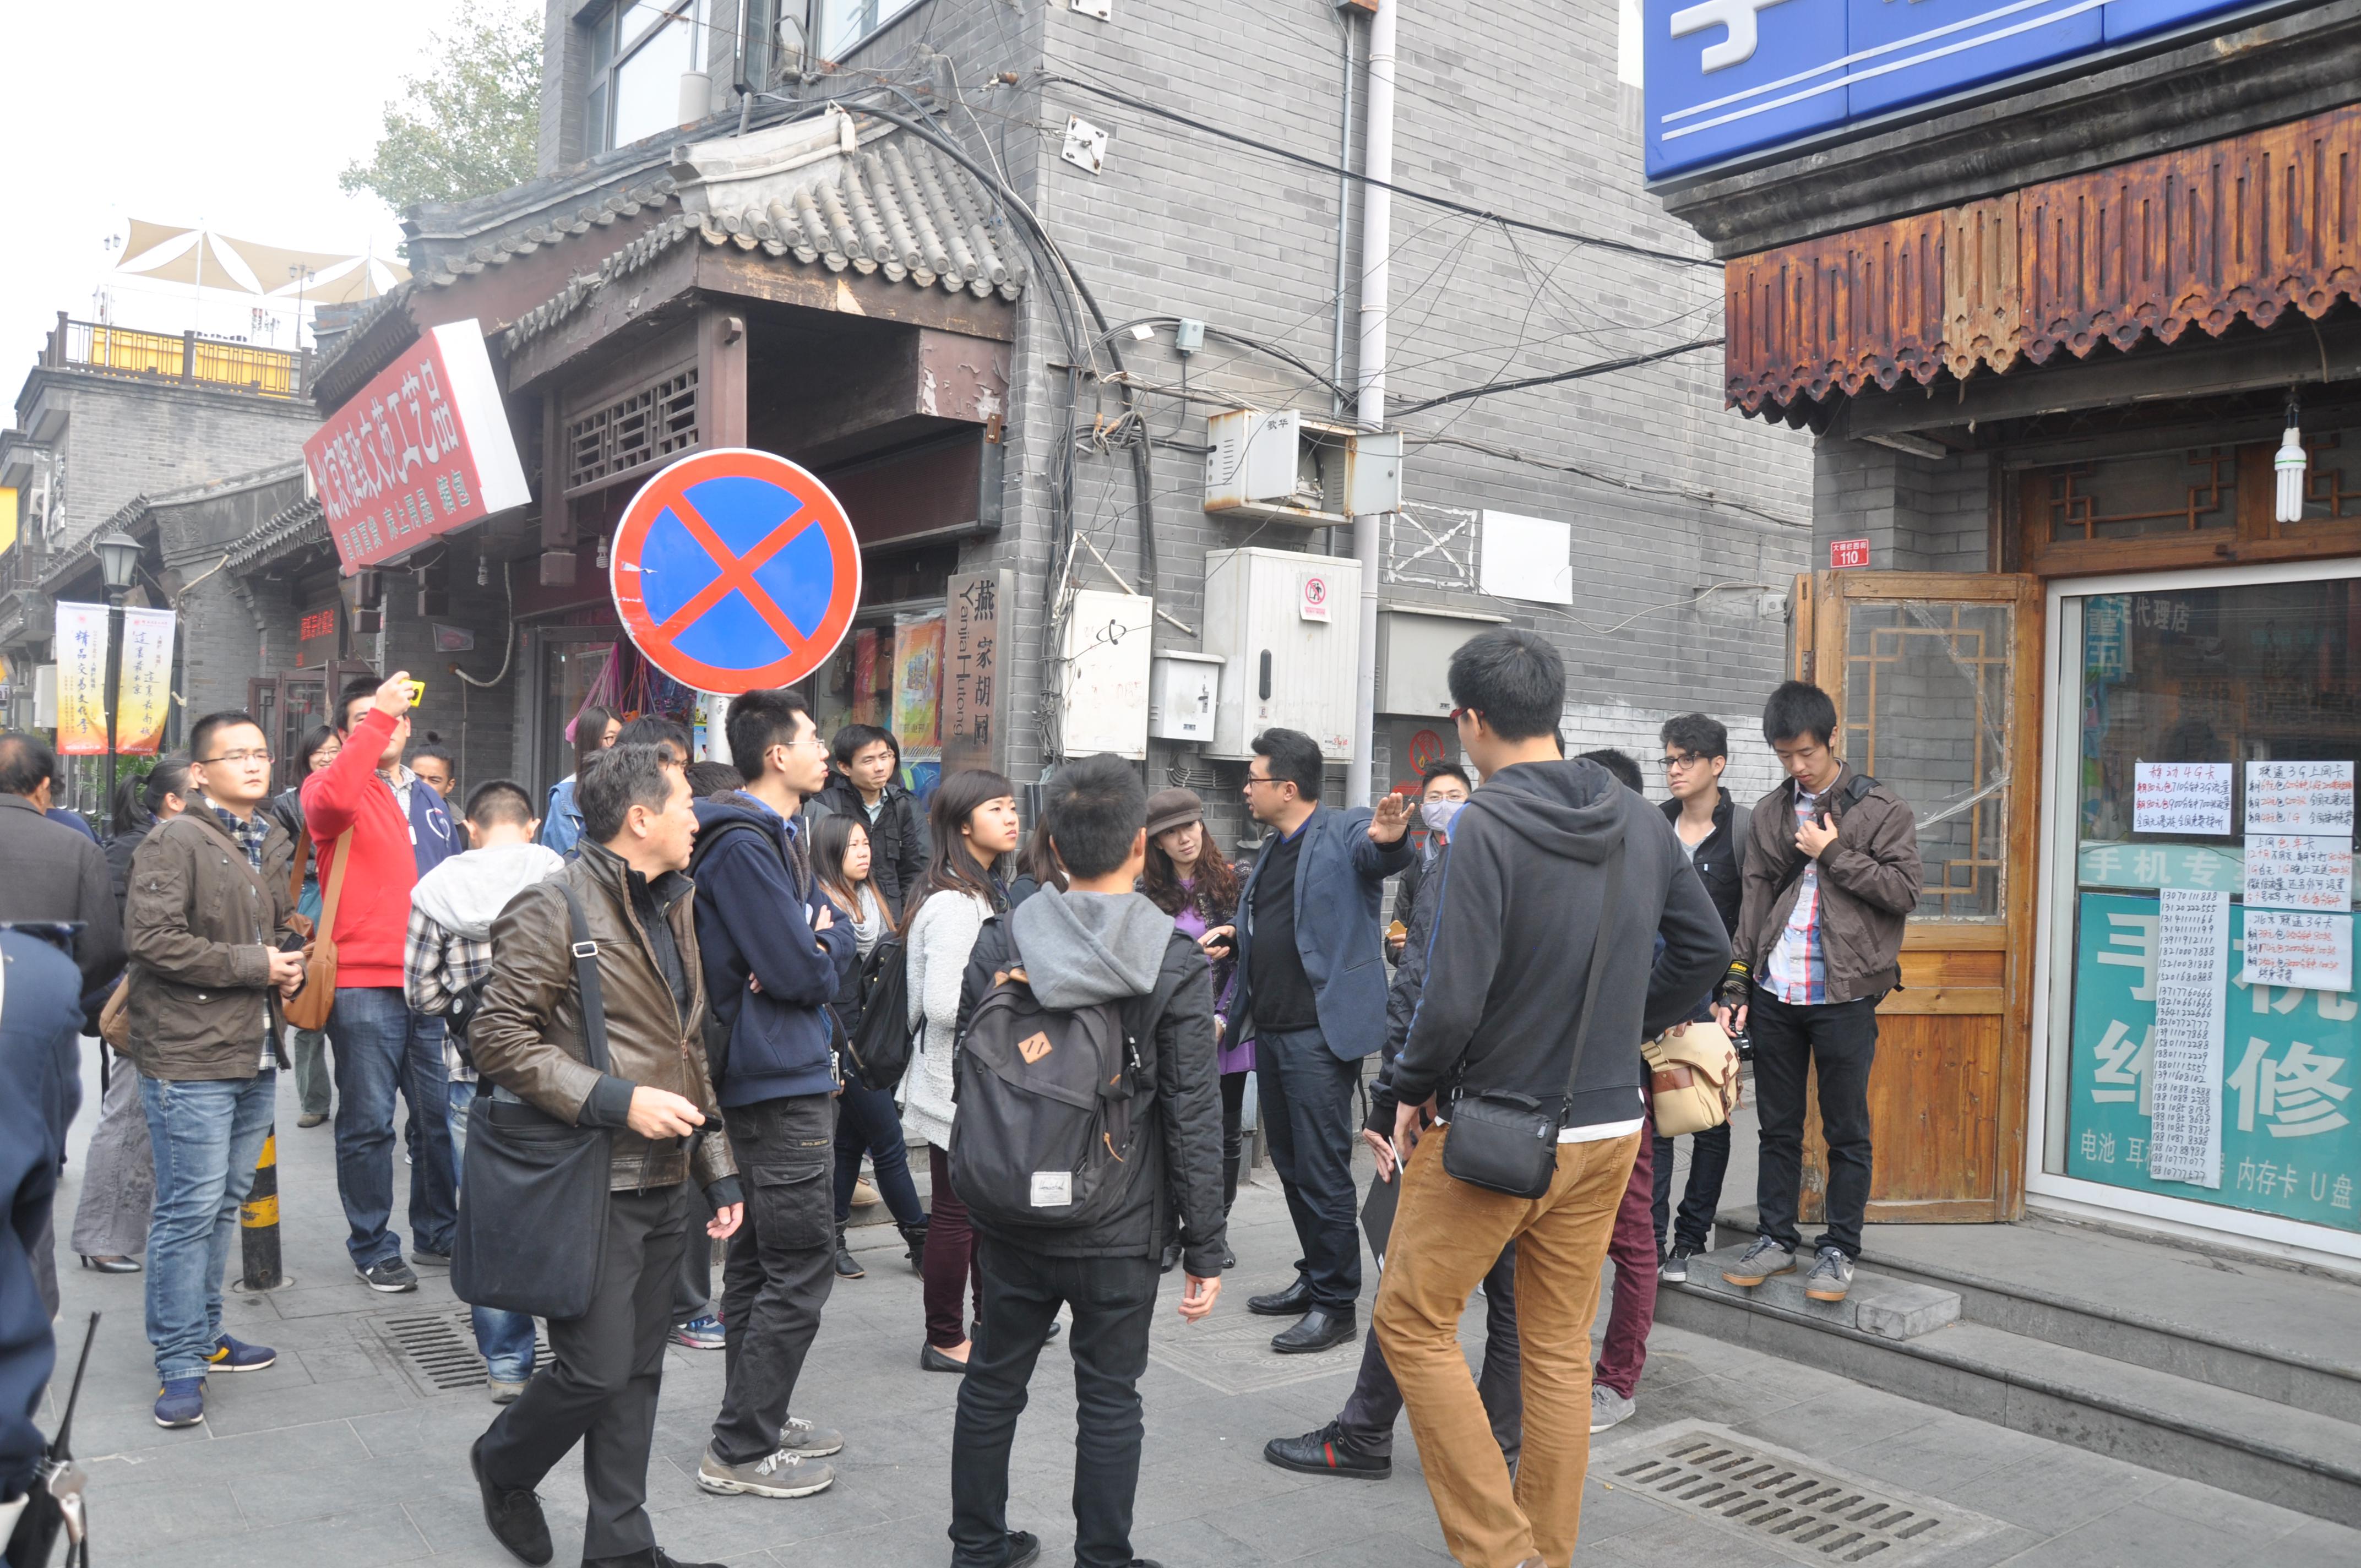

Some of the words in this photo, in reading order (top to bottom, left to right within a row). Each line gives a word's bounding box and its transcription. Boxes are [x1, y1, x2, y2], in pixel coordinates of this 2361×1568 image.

[1841, 551, 1858, 564] 110
[973, 580, 995, 747] 燕家胡同
[2086, 848, 2244, 889] 手机专
[2081, 1129, 2115, 1163] 电池
[2237, 1156, 2298, 1198] 内存卡
